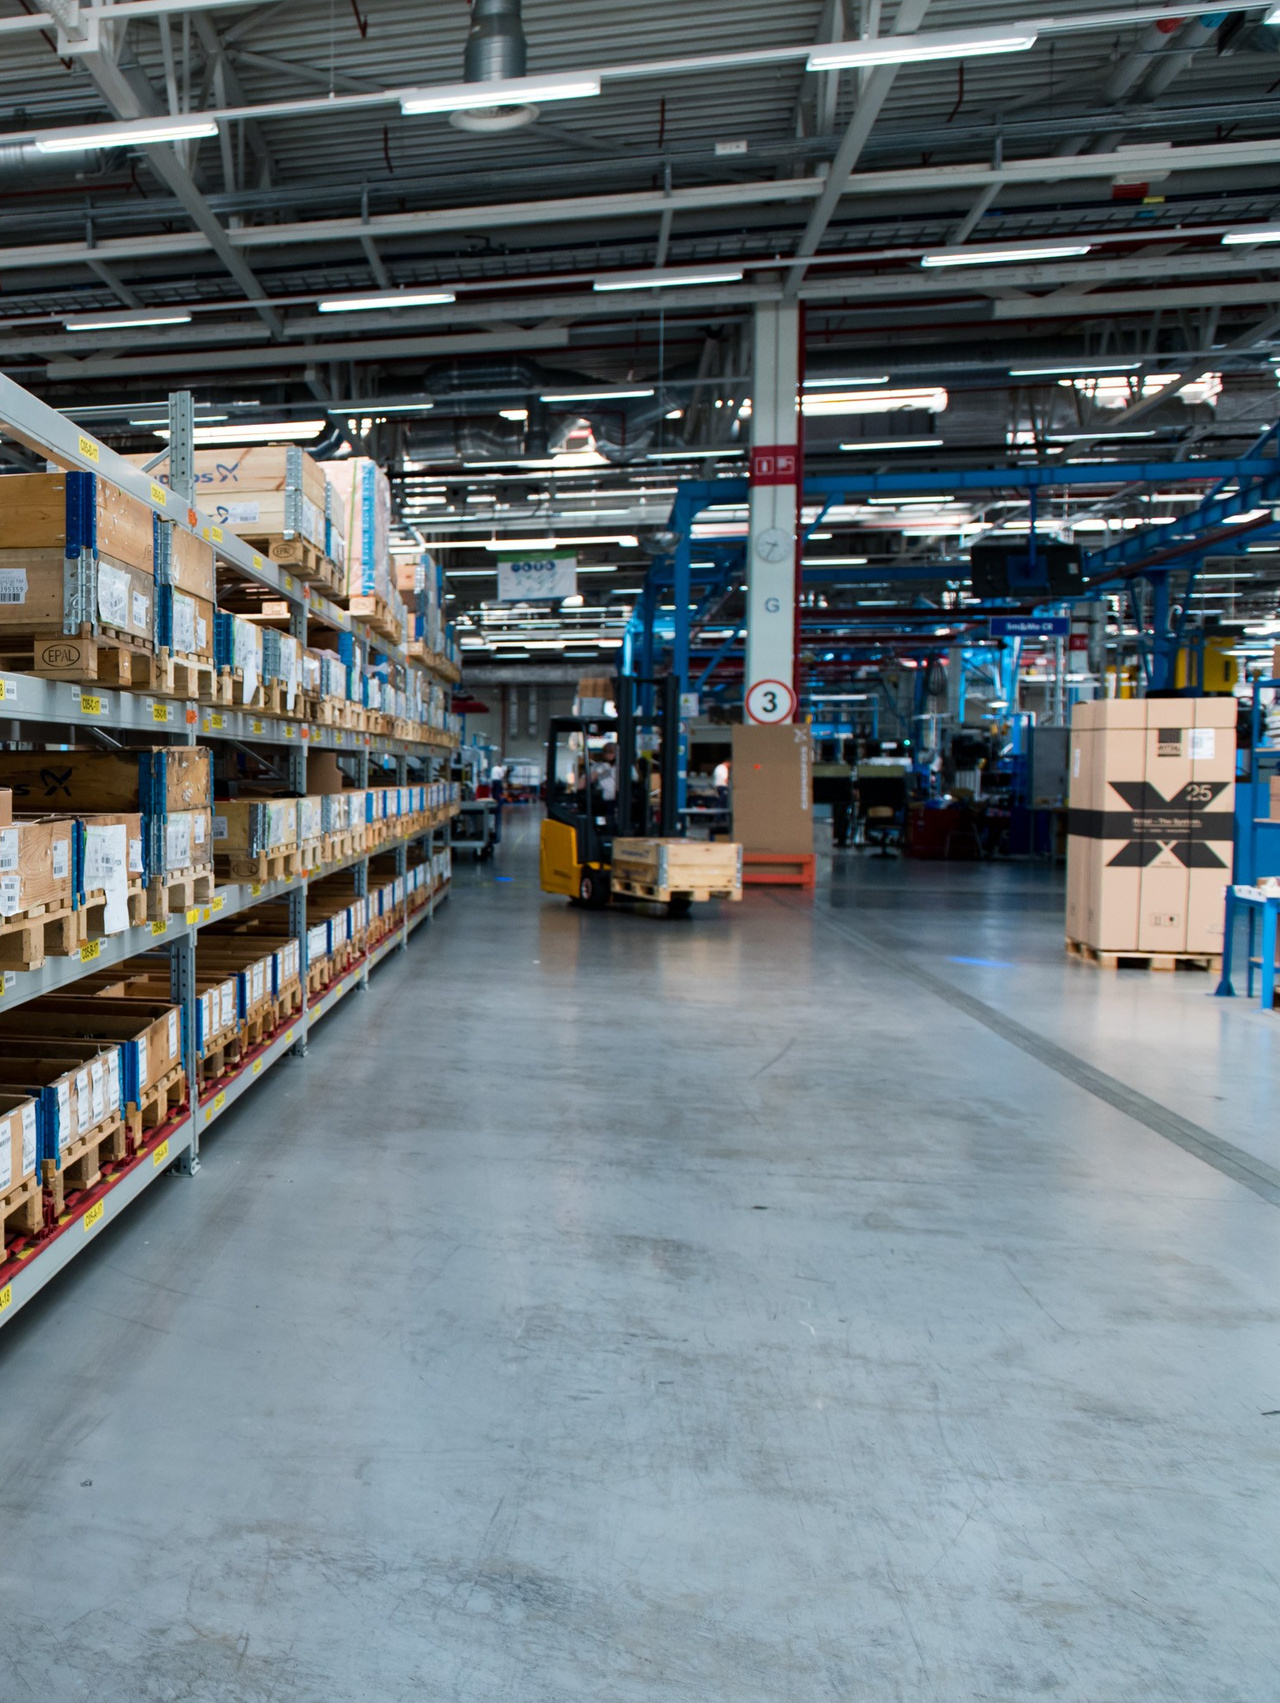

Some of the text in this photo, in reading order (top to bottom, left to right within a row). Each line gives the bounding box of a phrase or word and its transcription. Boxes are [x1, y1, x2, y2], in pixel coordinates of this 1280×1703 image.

[764, 597, 780, 613] G
[47, 646, 77, 666] EPAL
[762, 691, 778, 713] 3
[1185, 783, 1213, 802] 25
